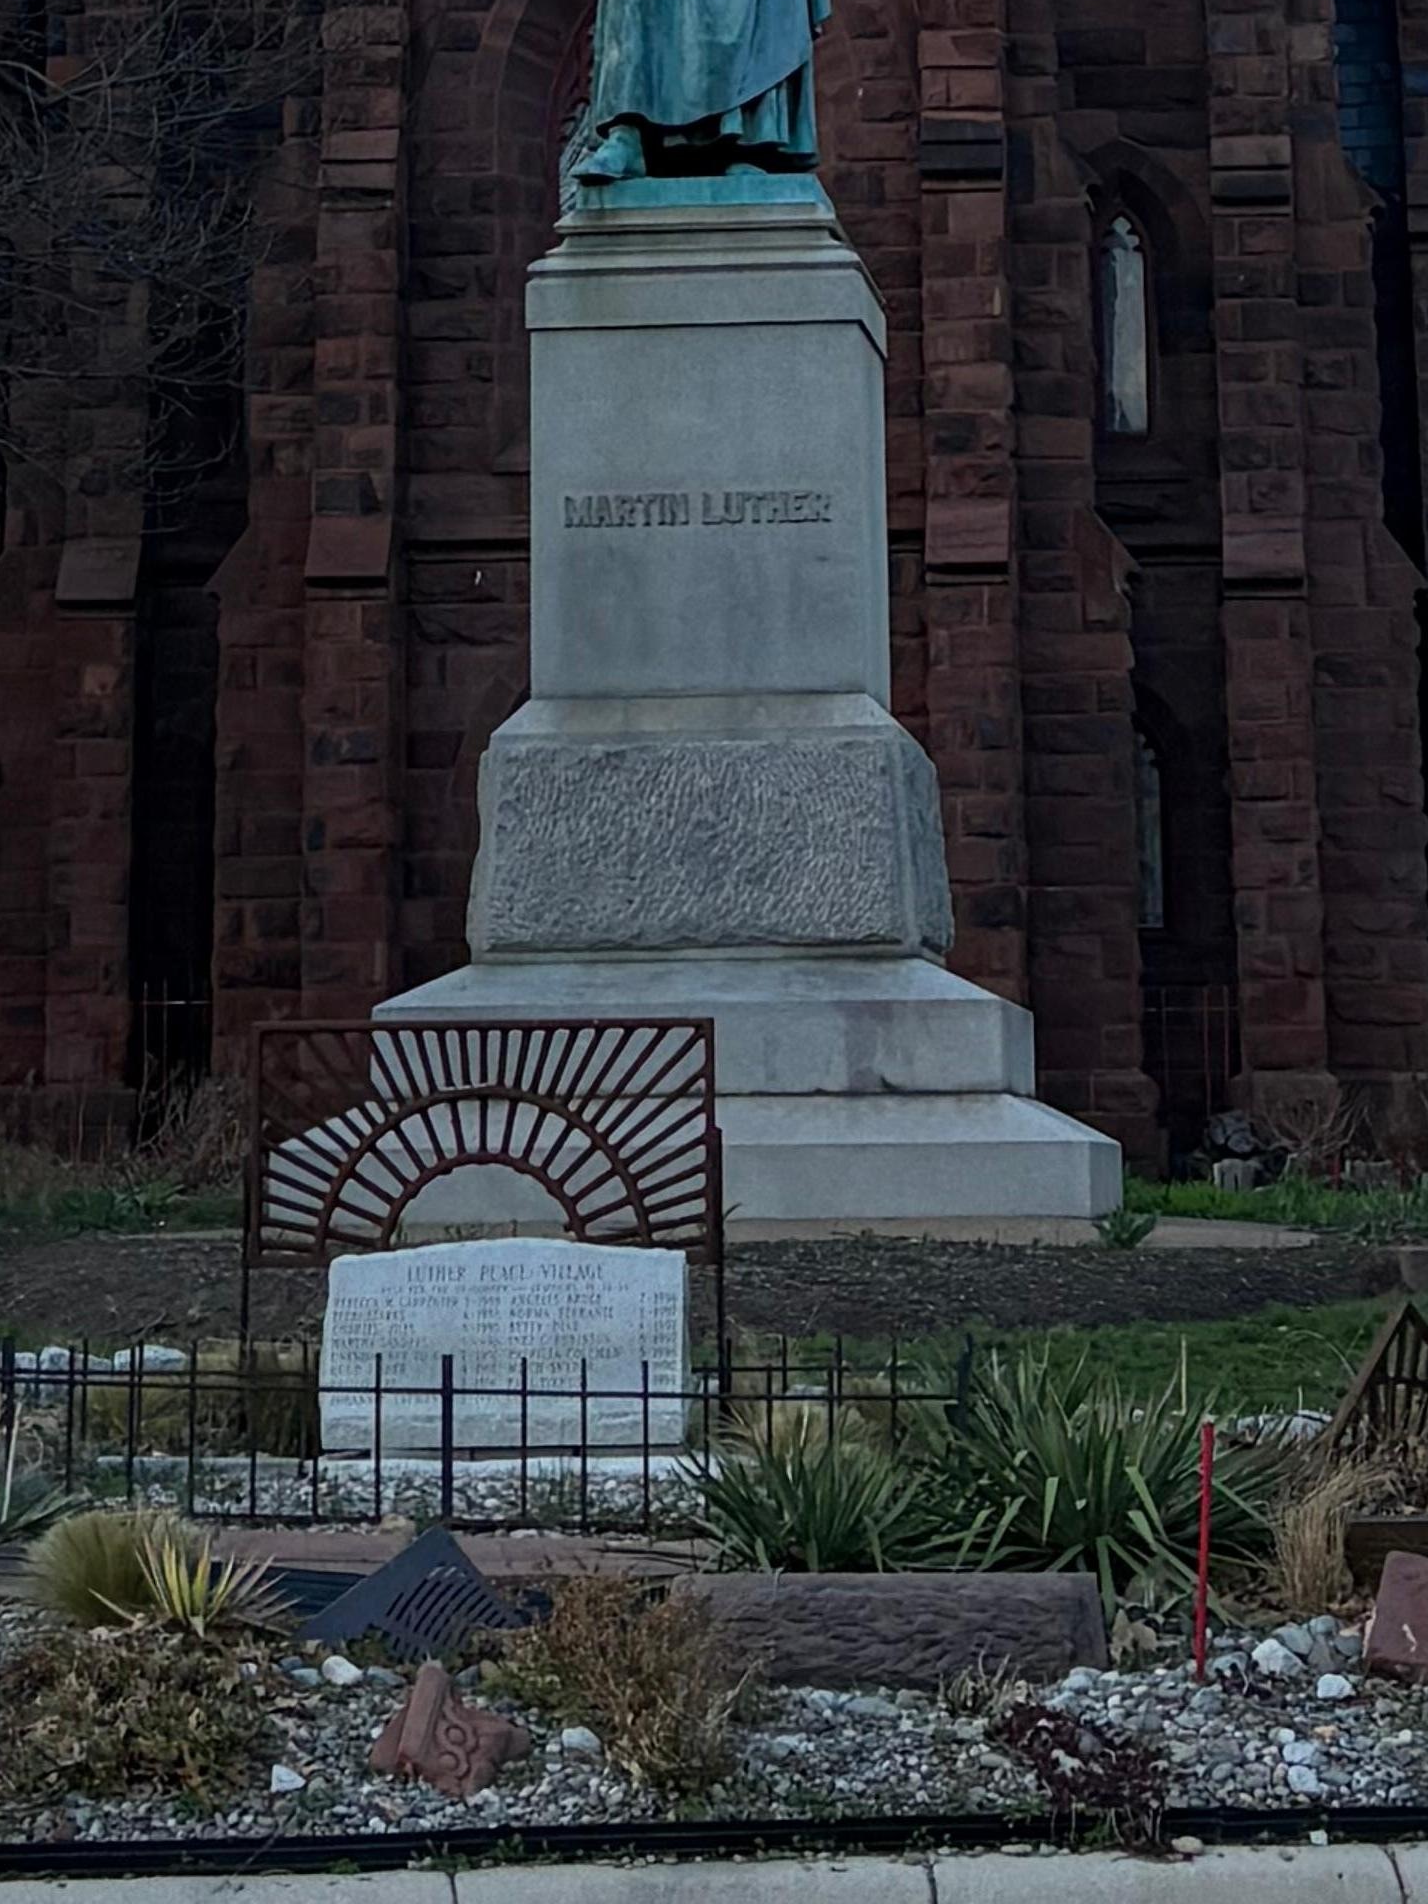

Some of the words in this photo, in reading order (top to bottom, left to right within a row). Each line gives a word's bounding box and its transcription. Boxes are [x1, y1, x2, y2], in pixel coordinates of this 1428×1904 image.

[564, 495, 690, 528] MARTIN
[702, 491, 833, 525] LUTHER
[407, 1264, 467, 1283] LUTHER
[480, 1263, 532, 1282] PLACE
[540, 1262, 604, 1281] VILLAGE
